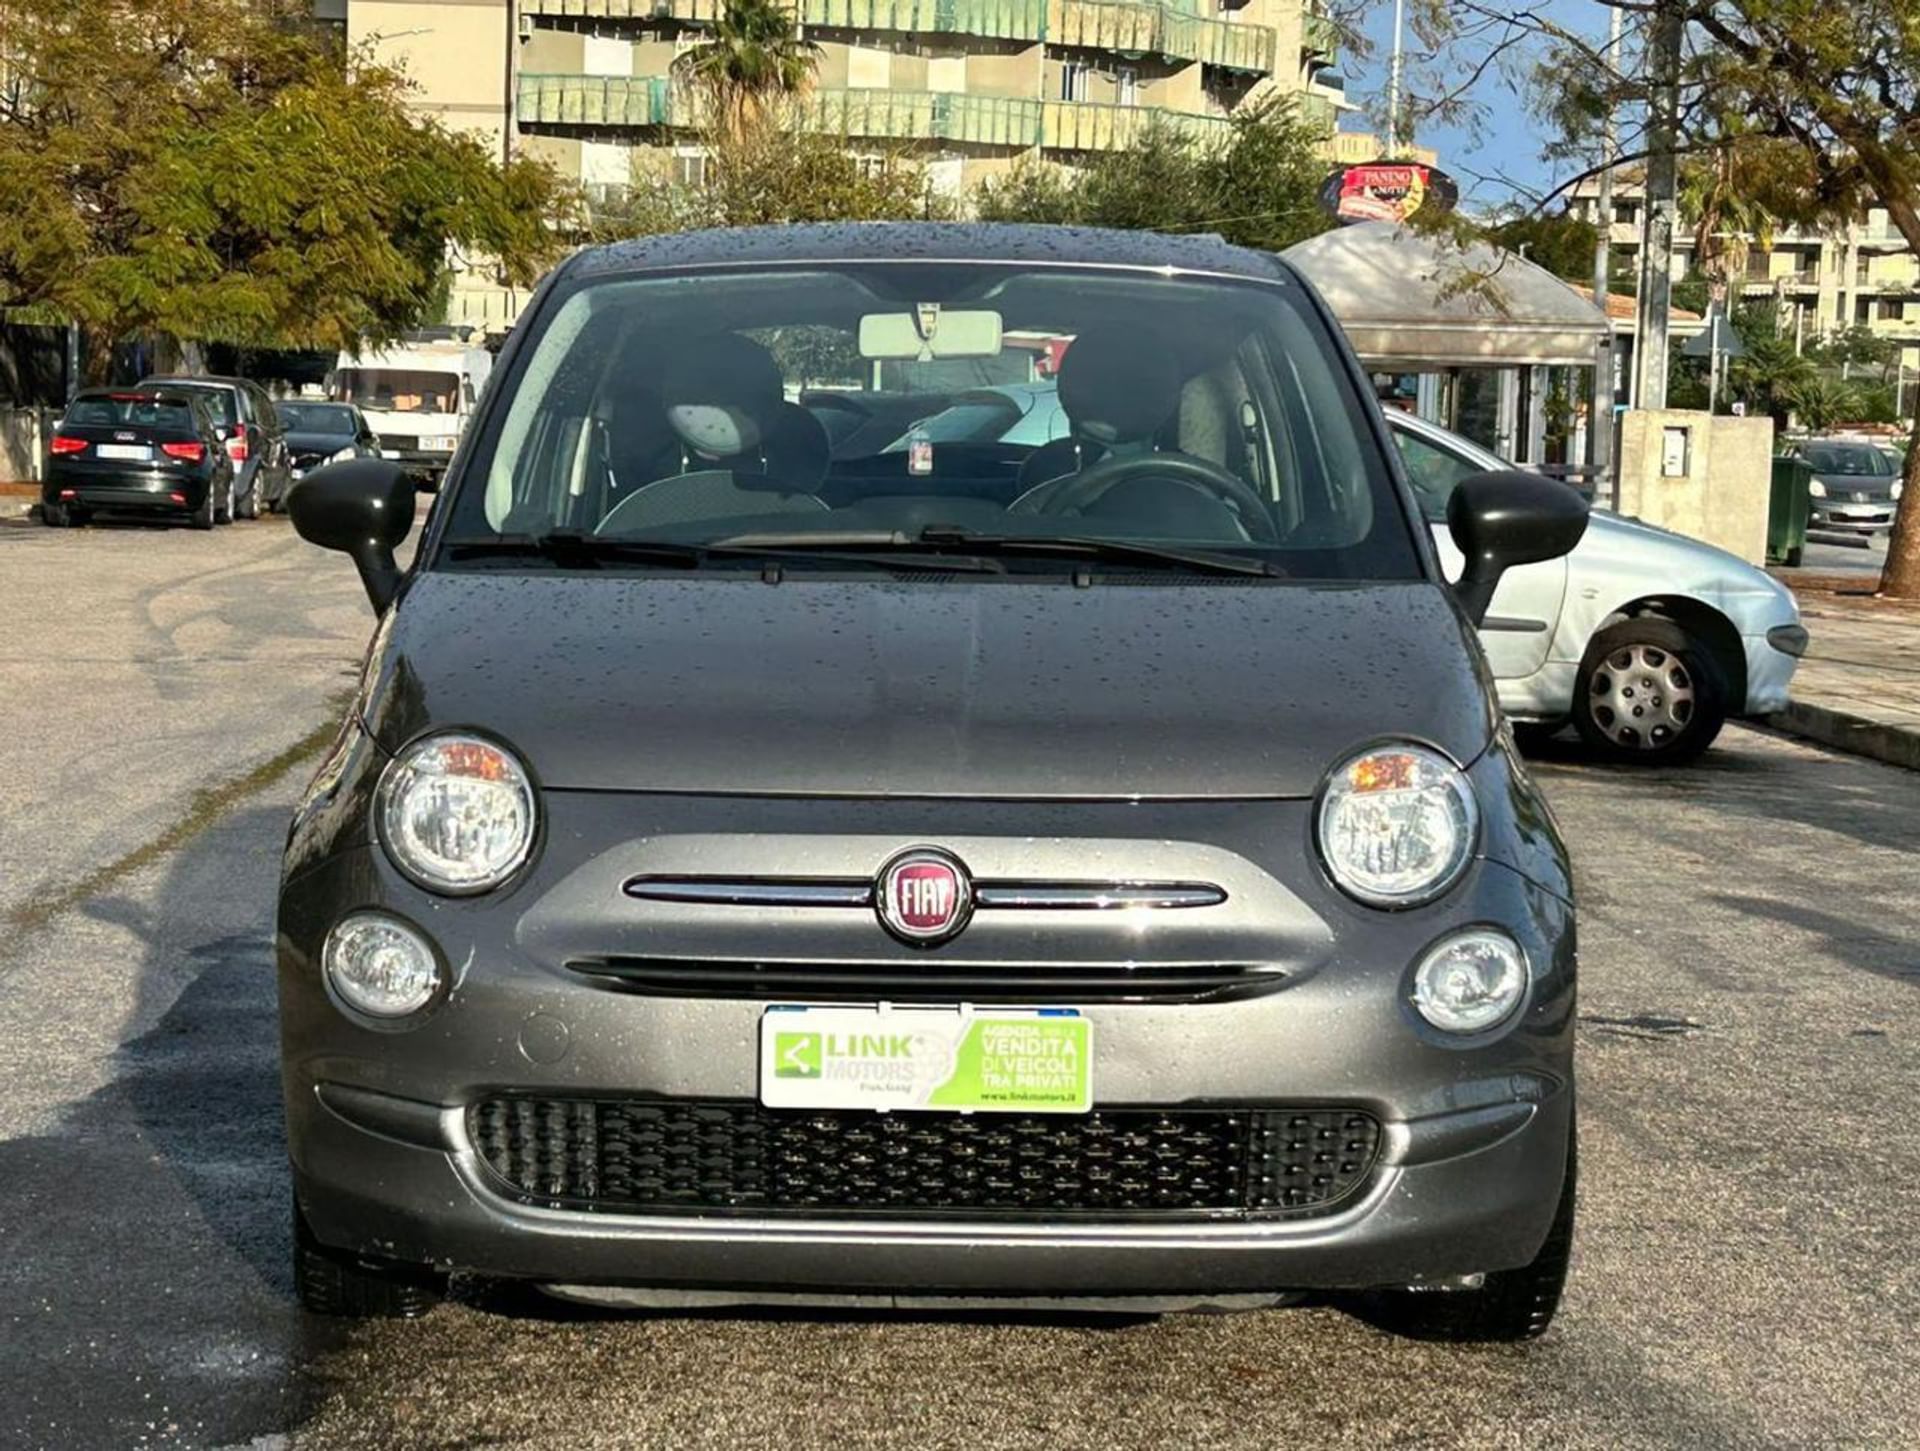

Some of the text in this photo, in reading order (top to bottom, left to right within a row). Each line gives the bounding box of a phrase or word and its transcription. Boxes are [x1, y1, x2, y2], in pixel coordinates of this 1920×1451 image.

[902, 878, 950, 916] FIAT
[826, 1034, 913, 1057] LINK
[983, 1037, 1078, 1056] VENDITA
[826, 1060, 914, 1081] MOTORS
[983, 1056, 1077, 1073] DI VEICOLI
[983, 1073, 1077, 1088] TRA PRIVATI
